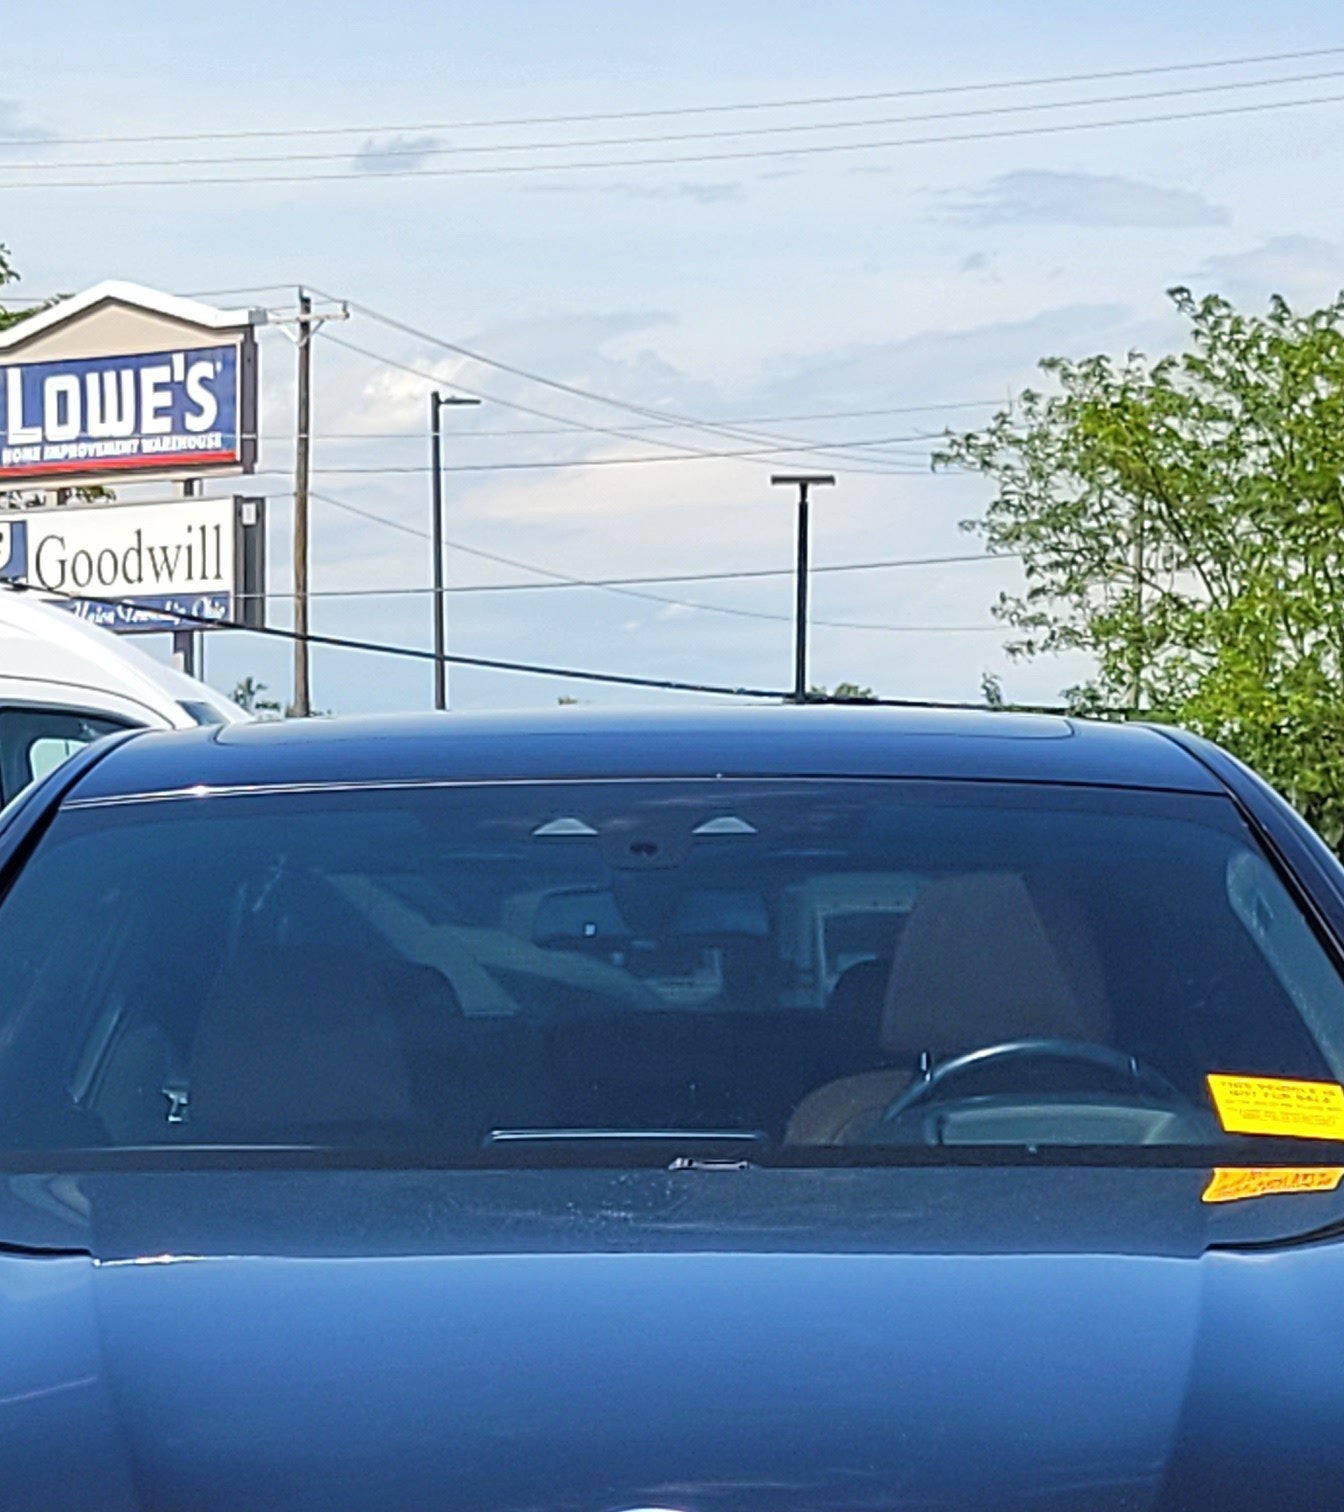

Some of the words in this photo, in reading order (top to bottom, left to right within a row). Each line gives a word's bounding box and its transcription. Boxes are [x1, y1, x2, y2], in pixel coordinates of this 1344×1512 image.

[7, 353, 219, 445] LOWE'S
[2, 445, 41, 464] HOME
[43, 439, 139, 460] IMPROVEMENT
[142, 433, 222, 453] WAREHOUSE
[35, 523, 225, 590] Goodwill
